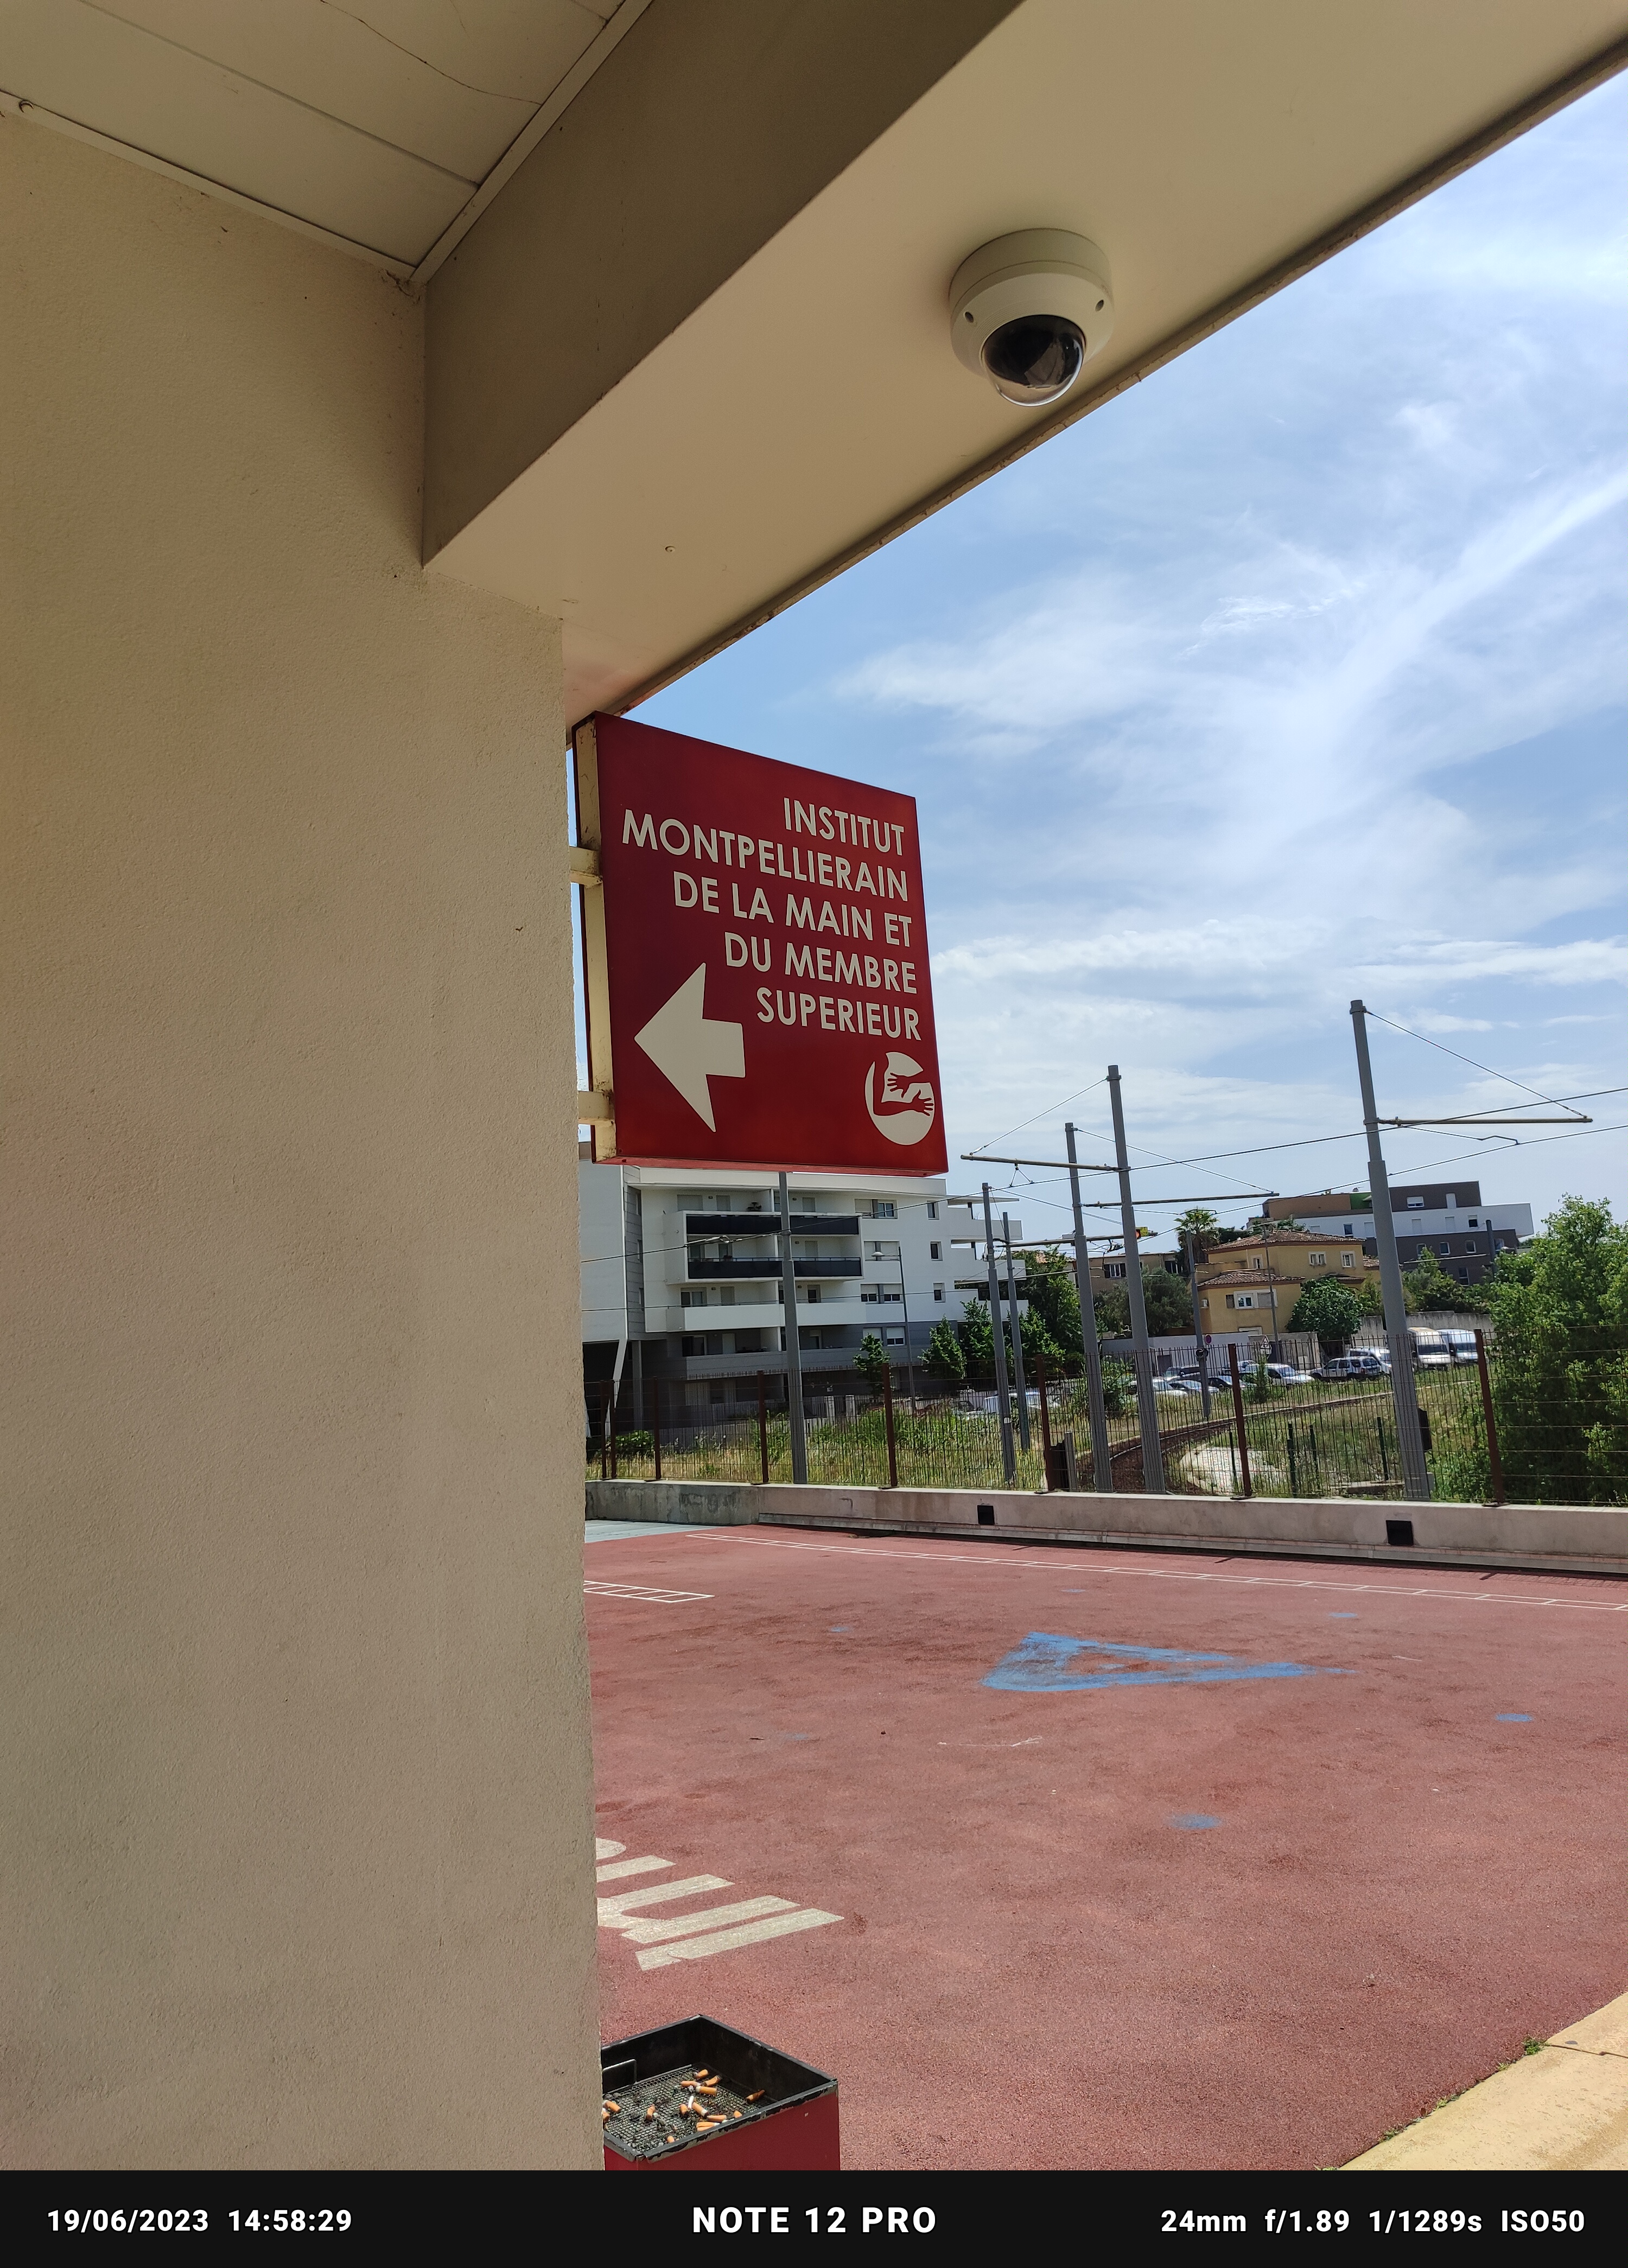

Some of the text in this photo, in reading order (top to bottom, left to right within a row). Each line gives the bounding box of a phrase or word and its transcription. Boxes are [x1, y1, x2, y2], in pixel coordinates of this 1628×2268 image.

[621, 808, 908, 902] MONTPELLIERAIN
[783, 797, 905, 856] INSTITUT
[673, 870, 912, 948] DE LA MAIN ET
[724, 931, 918, 995] DU MEMBRE
[756, 986, 922, 1041] SUPERIEUR
